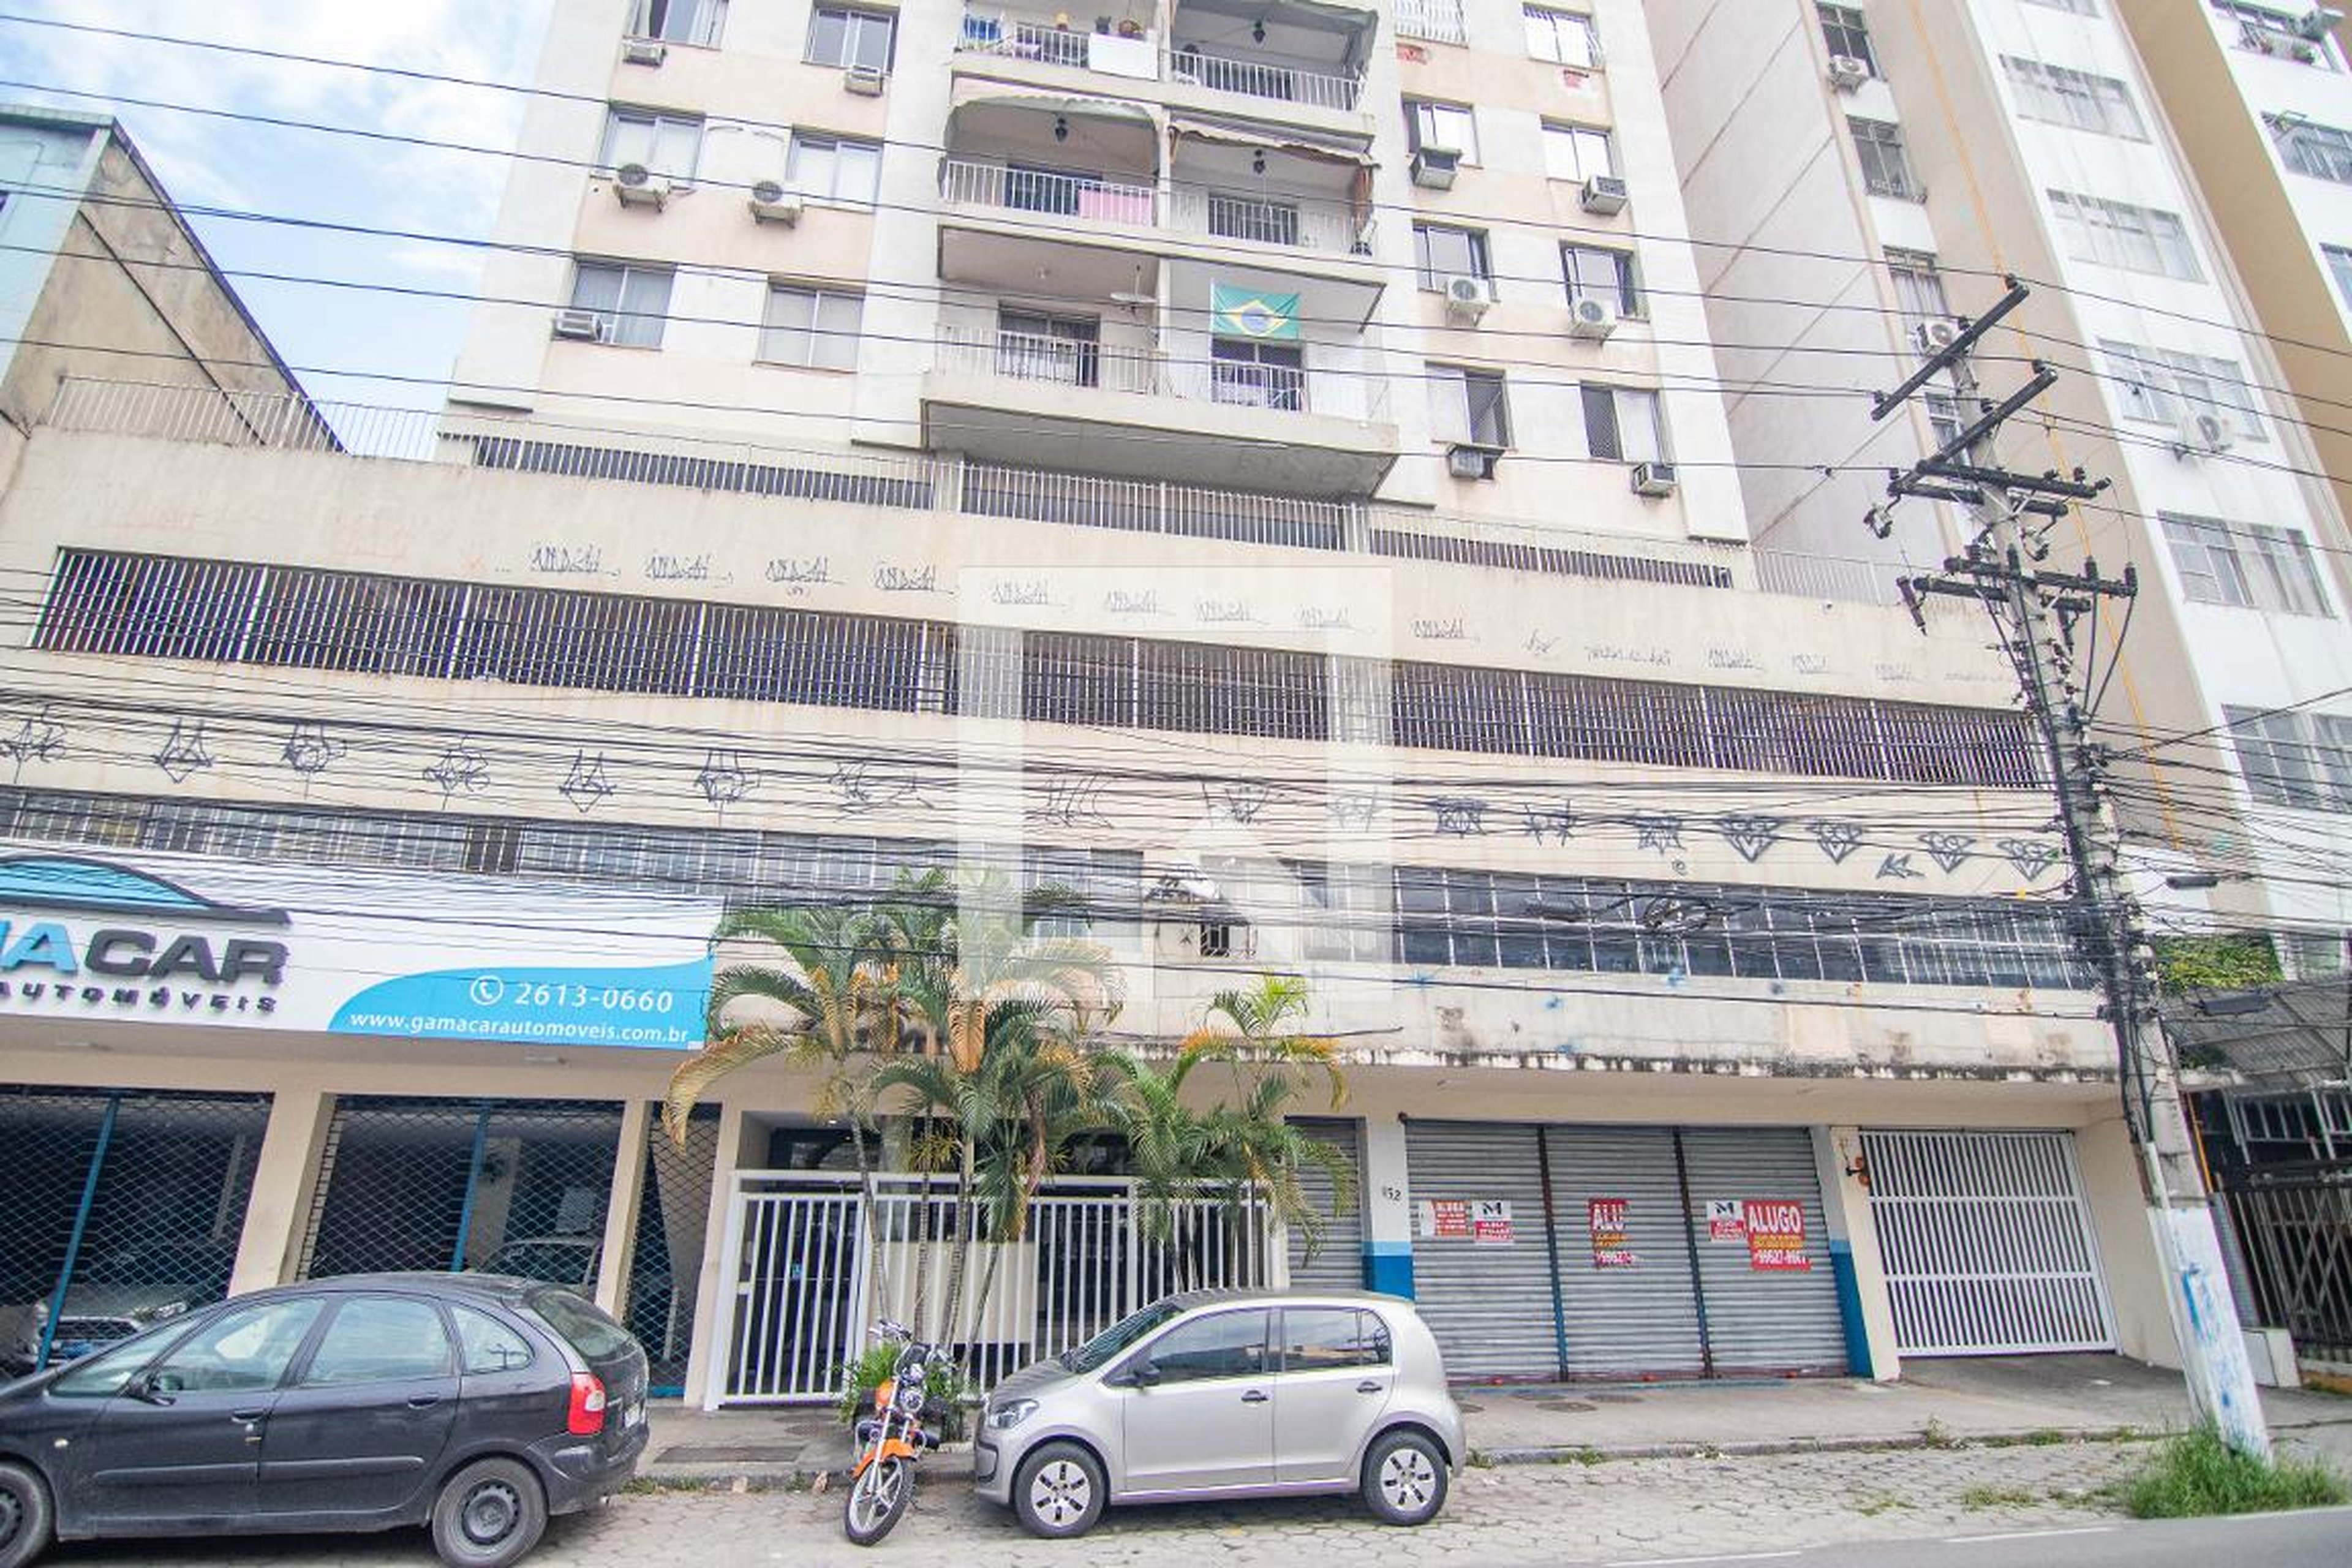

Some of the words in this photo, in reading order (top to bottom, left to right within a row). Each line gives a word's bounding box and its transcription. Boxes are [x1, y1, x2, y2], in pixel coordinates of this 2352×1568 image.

[0, 921, 289, 984] ACAR
[515, 982, 673, 1013] 2613-0660
[350, 1012, 688, 1042] www.gamacarautomoveis.com.br
[1749, 1205, 1801, 1233] ALUGO
